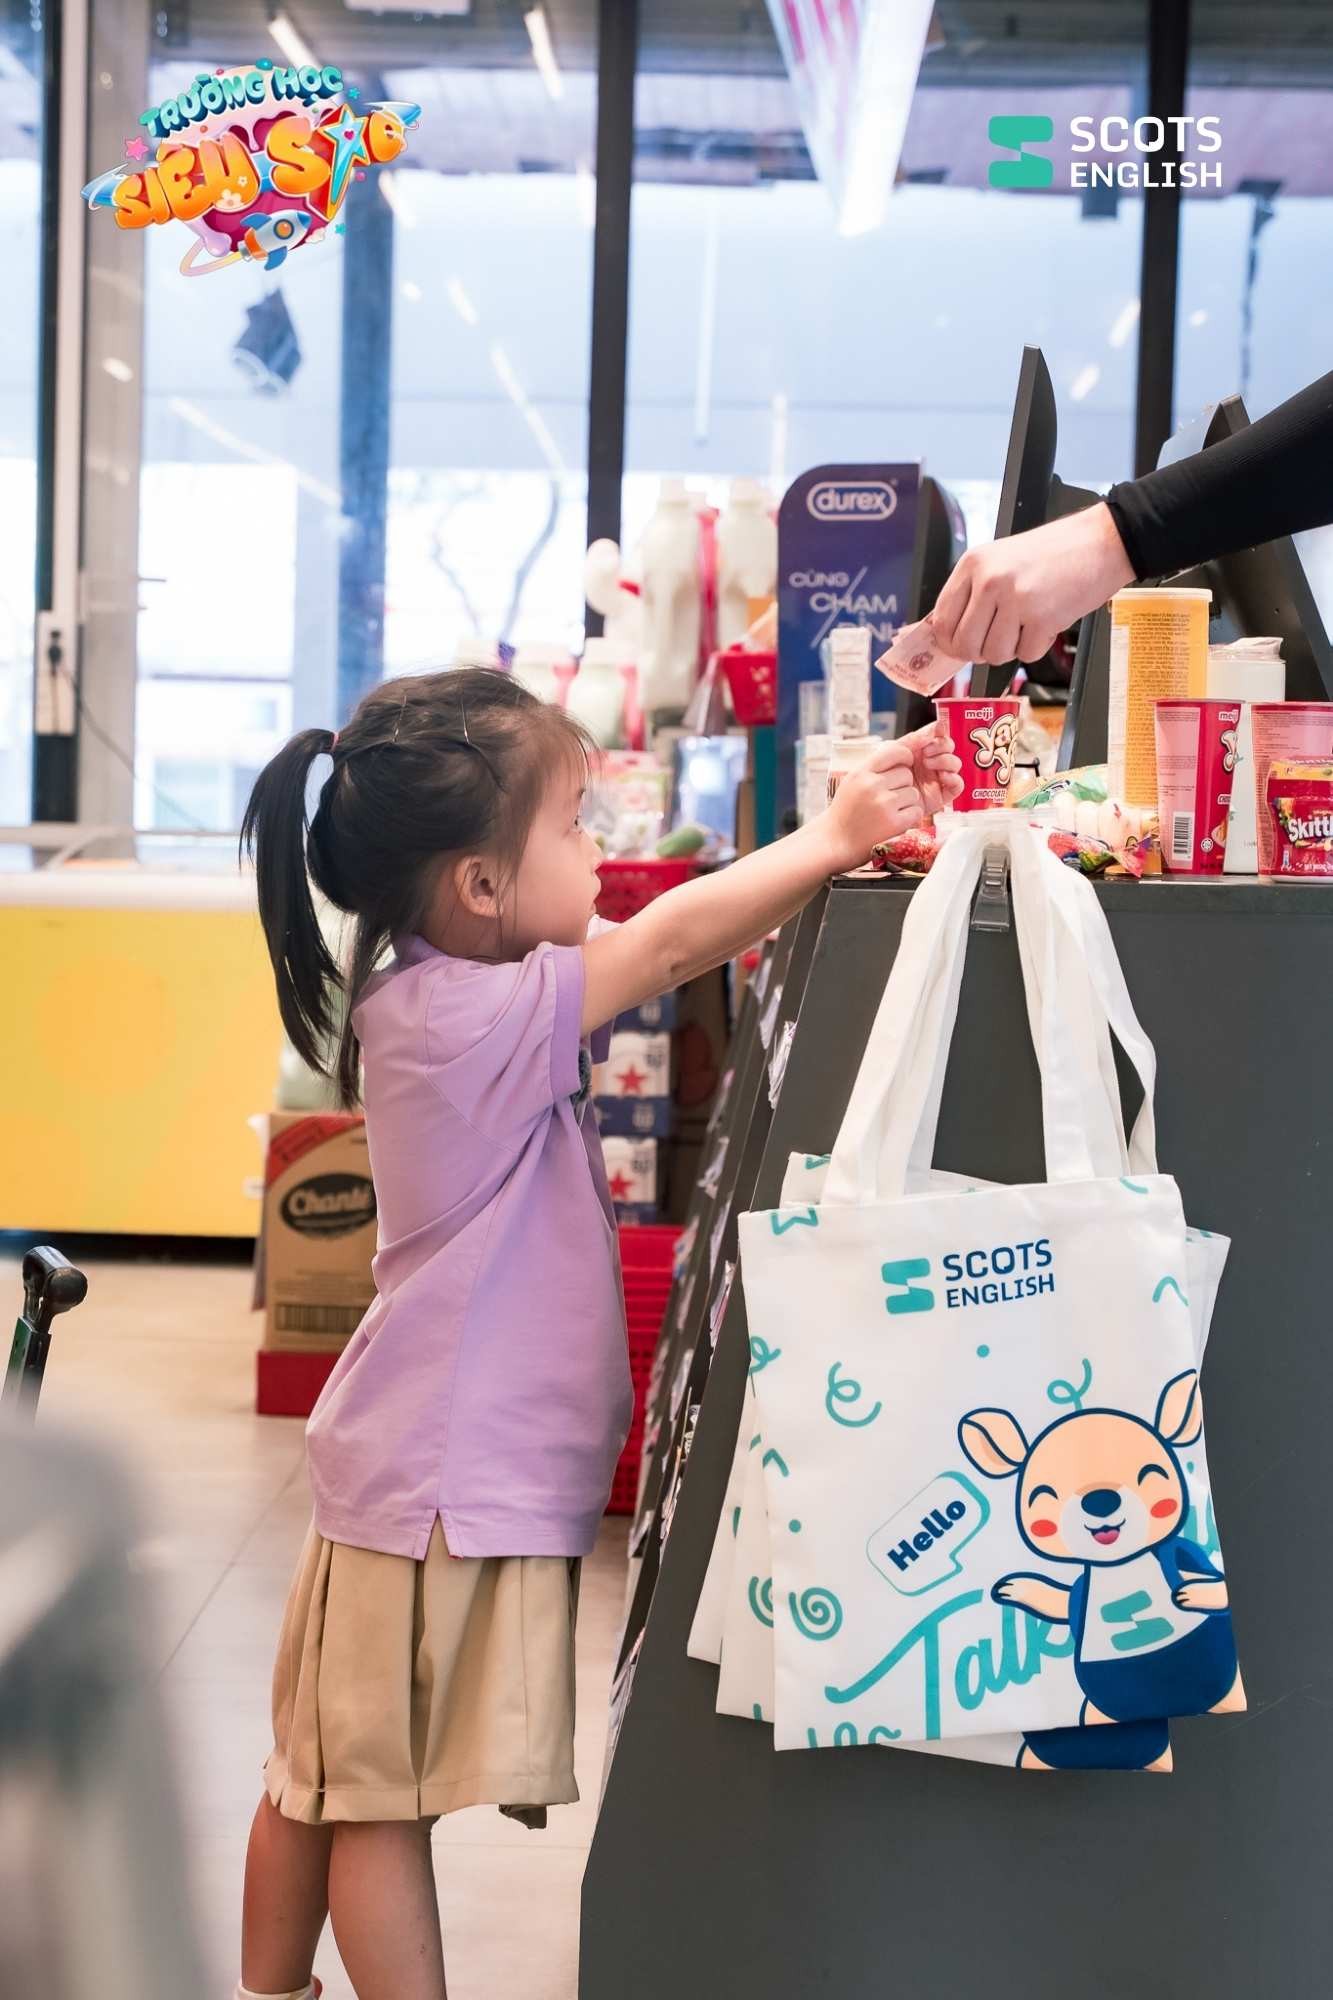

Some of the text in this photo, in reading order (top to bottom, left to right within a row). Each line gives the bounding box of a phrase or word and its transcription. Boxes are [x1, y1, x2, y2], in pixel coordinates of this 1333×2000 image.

[814, 487, 891, 515] durex
[966, 707, 993, 719] meiji
[942, 1238, 1053, 1282] SCOTS
[946, 1272, 1055, 1309] ENGLISH
[887, 1499, 966, 1571] Hello
[824, 1588, 1076, 1740] Talk
